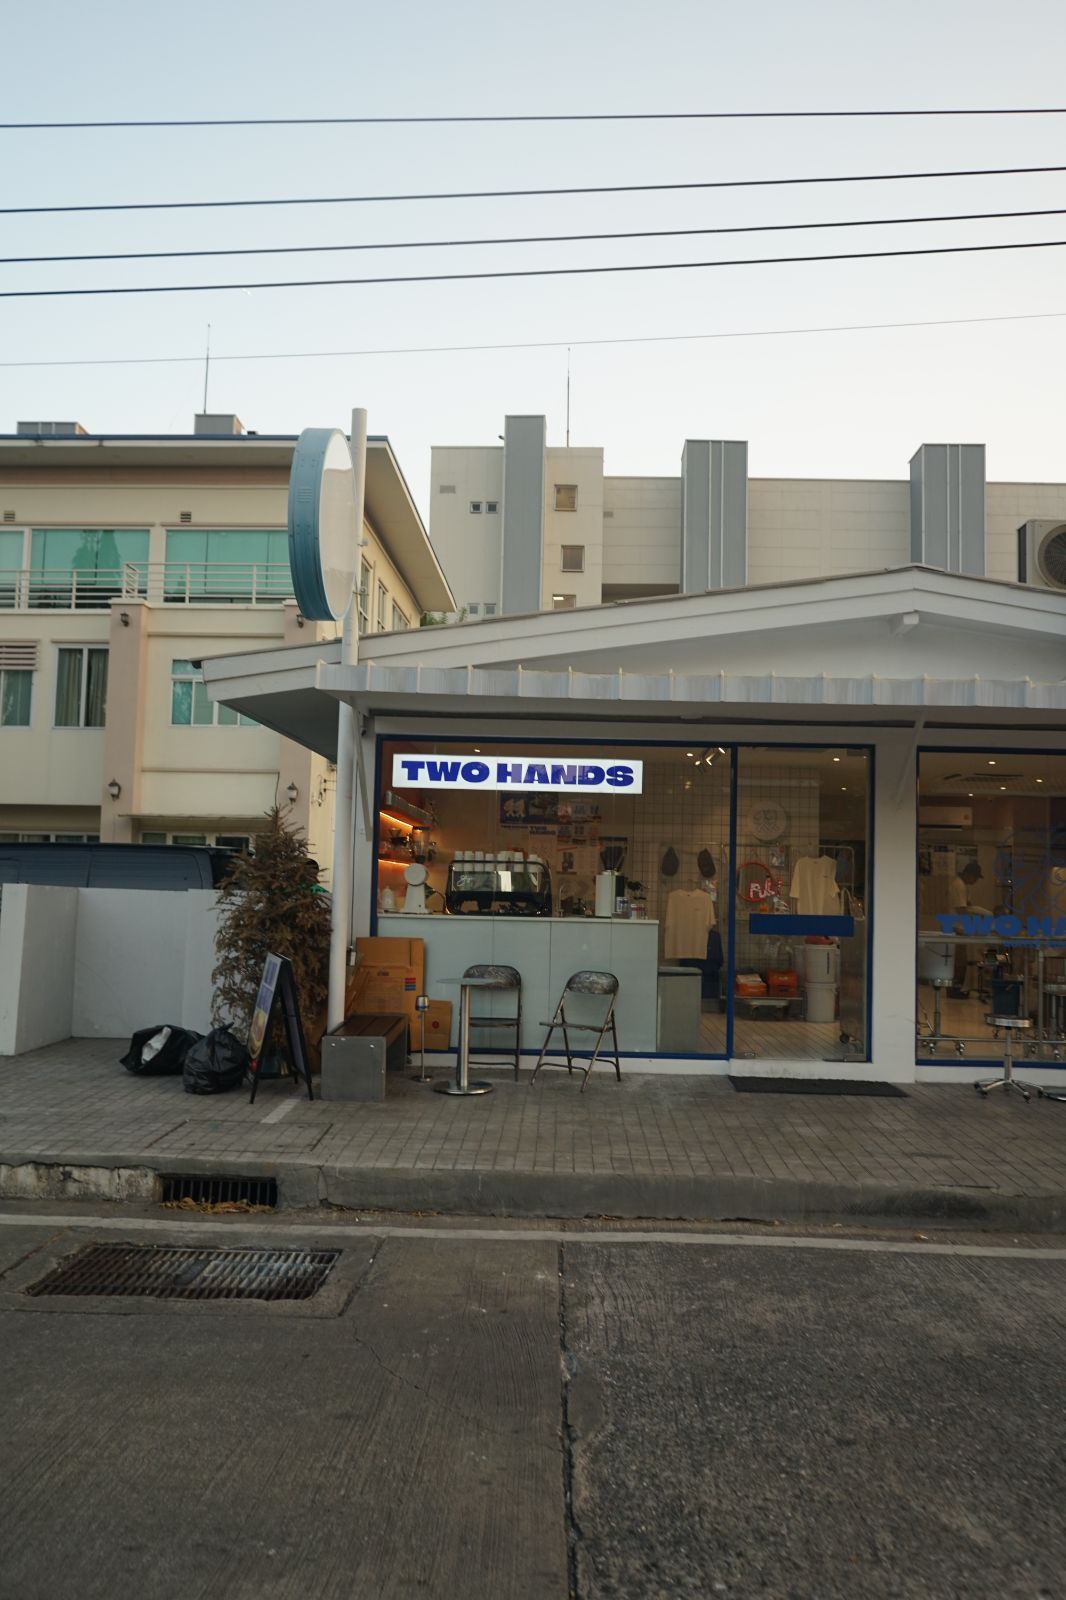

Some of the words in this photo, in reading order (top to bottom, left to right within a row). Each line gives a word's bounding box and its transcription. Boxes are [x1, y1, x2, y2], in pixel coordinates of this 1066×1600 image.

[401, 760, 490, 783] TWO
[496, 763, 635, 787] HANDS
[936, 913, 1021, 937] TWO
